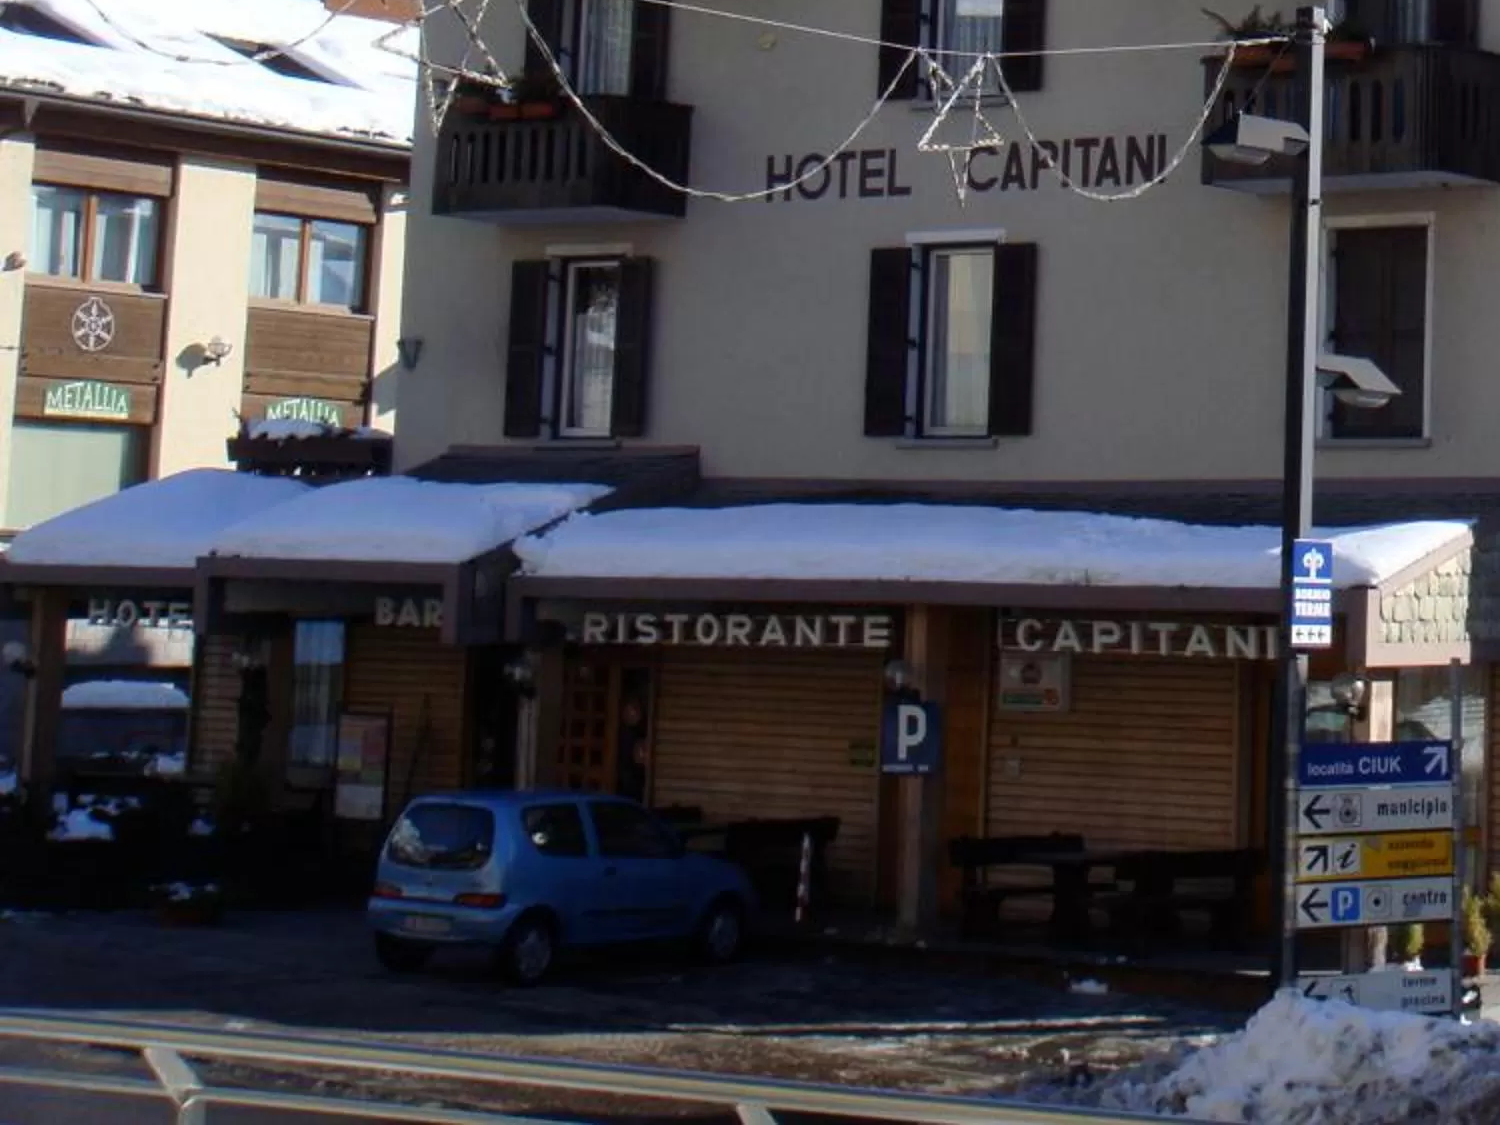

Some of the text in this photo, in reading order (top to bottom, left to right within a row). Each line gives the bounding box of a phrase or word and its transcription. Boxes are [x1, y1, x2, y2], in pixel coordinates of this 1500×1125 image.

[766, 134, 1168, 203] HOTEL CAPITANI
[46, 381, 129, 412] METALLIA
[88, 599, 193, 628] HOTE
[375, 596, 444, 628] BAR
[583, 612, 891, 648] RISTORANTE
[1016, 618, 1278, 660] CAPITANI
[898, 704, 927, 761] P
[1358, 756, 1402, 774] CIUK
[1377, 797, 1448, 819] municipio
